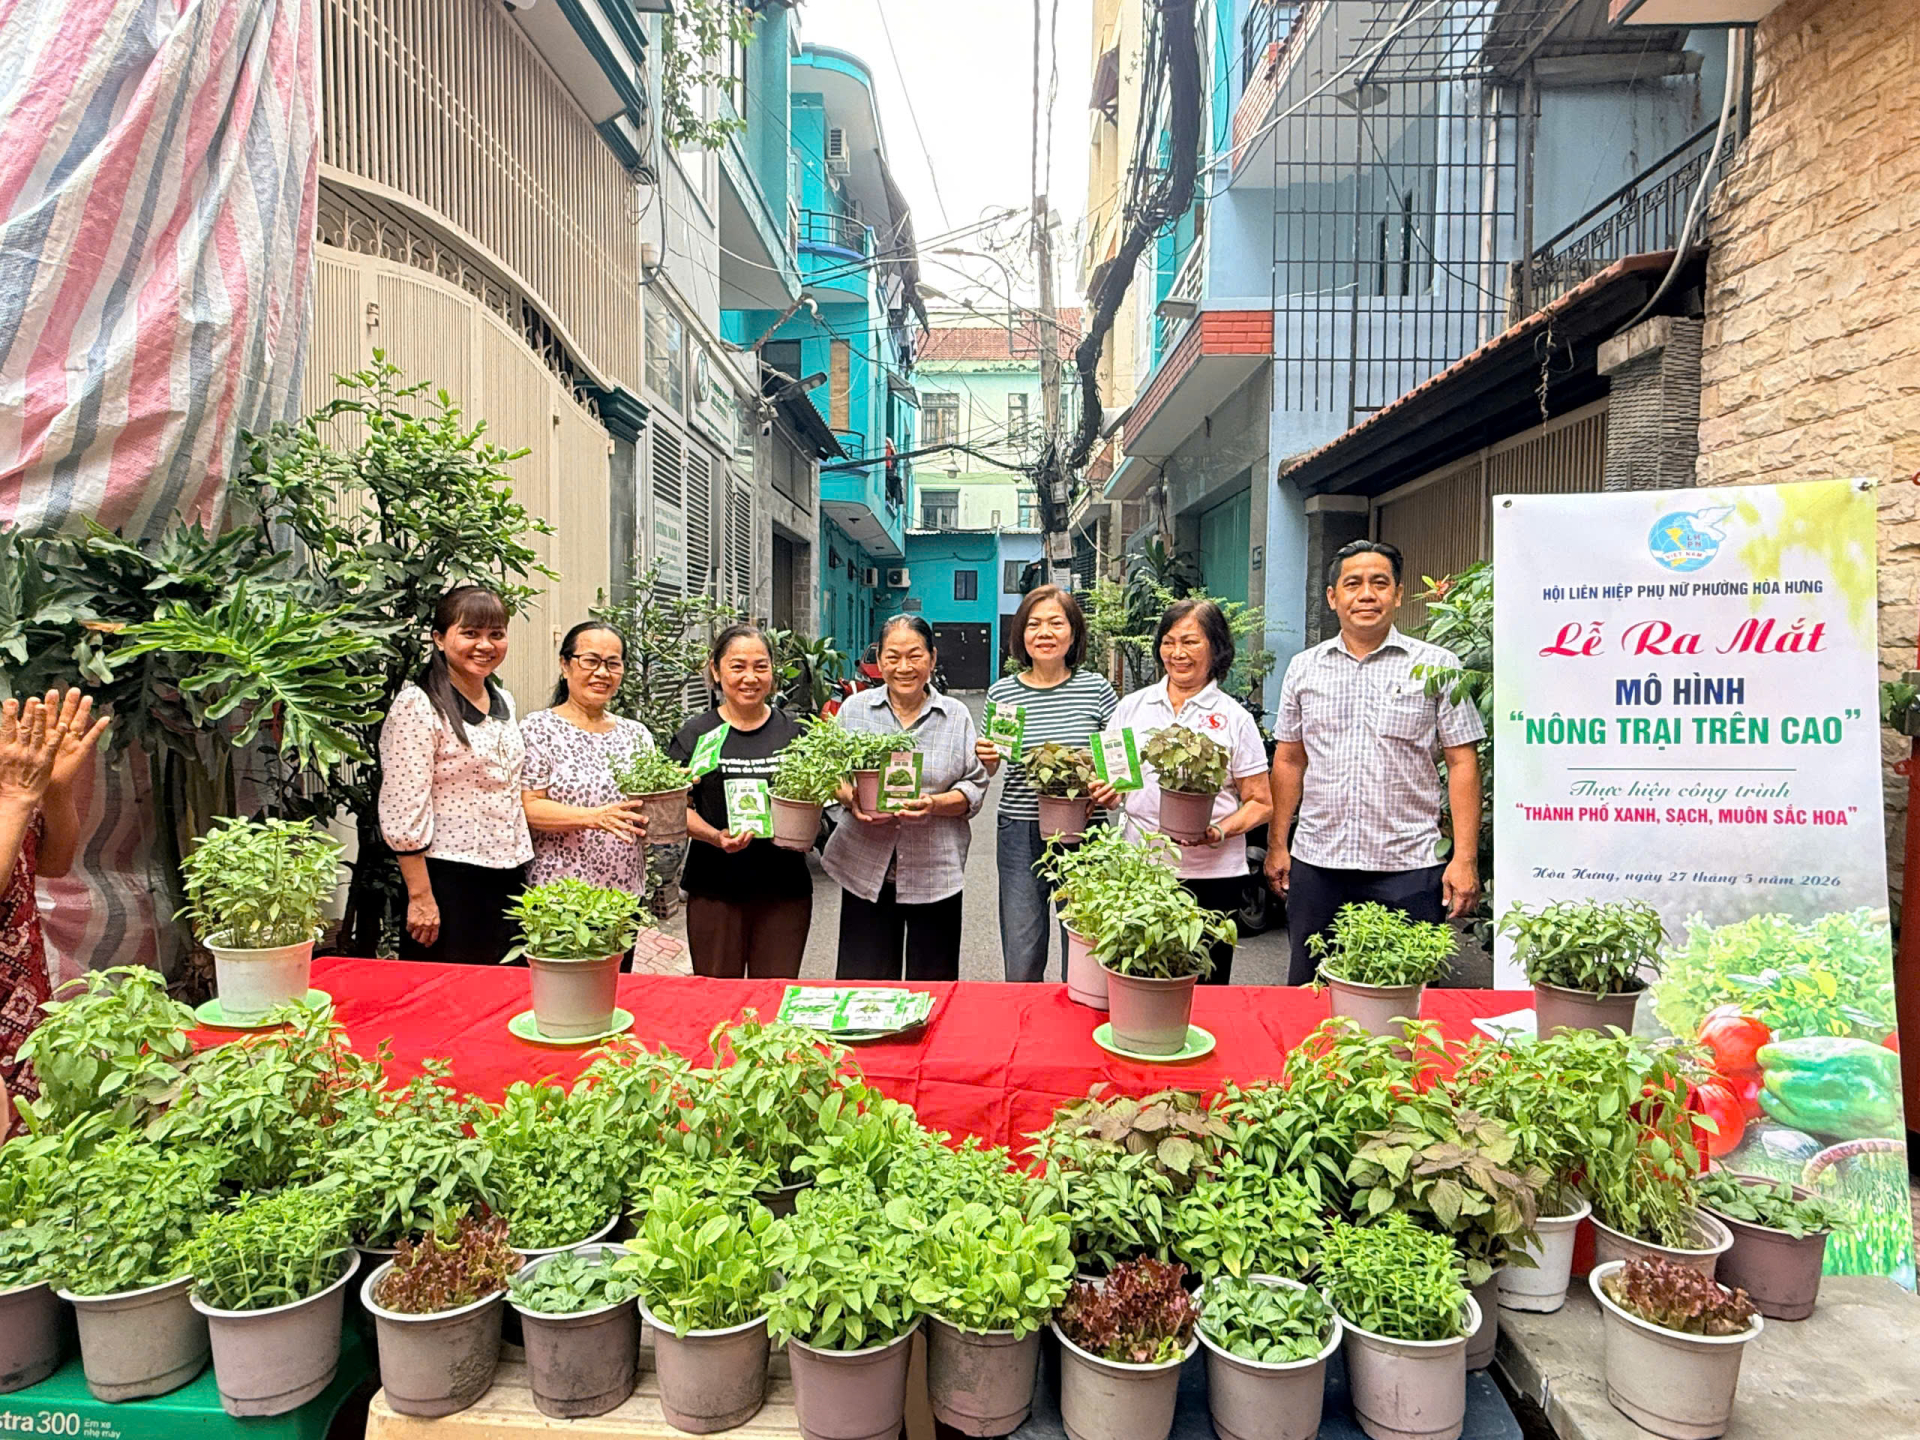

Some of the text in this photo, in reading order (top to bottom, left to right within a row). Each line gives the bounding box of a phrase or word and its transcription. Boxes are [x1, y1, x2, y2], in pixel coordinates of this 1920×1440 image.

[1542, 579, 1824, 603] HỘI LIÊN HIỆP PHỤ NỮ PHƯỜNG HÒA HƯNG
[1538, 616, 1828, 658] Lễ Ra Mắt
[1615, 671, 1745, 706] MÔ HÌNH
[1616, 715, 1682, 751] TRẠI
[1691, 710, 1770, 745] TRÊN
[1569, 779, 1792, 805] Thực hiện công trình
[1578, 802, 1610, 823] PHỐ
[1614, 806, 1661, 825] XANH,
[1665, 807, 1714, 827] SẠCH,
[1718, 806, 1768, 825] MUÔN
[1772, 804, 1808, 825] SẮC
[1531, 866, 1566, 880] Hòa
[1572, 866, 1620, 883] Hưng,
[1624, 871, 1663, 884] ngày
[1667, 871, 1688, 882] 27
[1692, 871, 1738, 886] tháng
[1757, 874, 1796, 886] năm
[1799, 875, 1842, 887] 2026
[0, 1410, 81, 1436] tra 300
